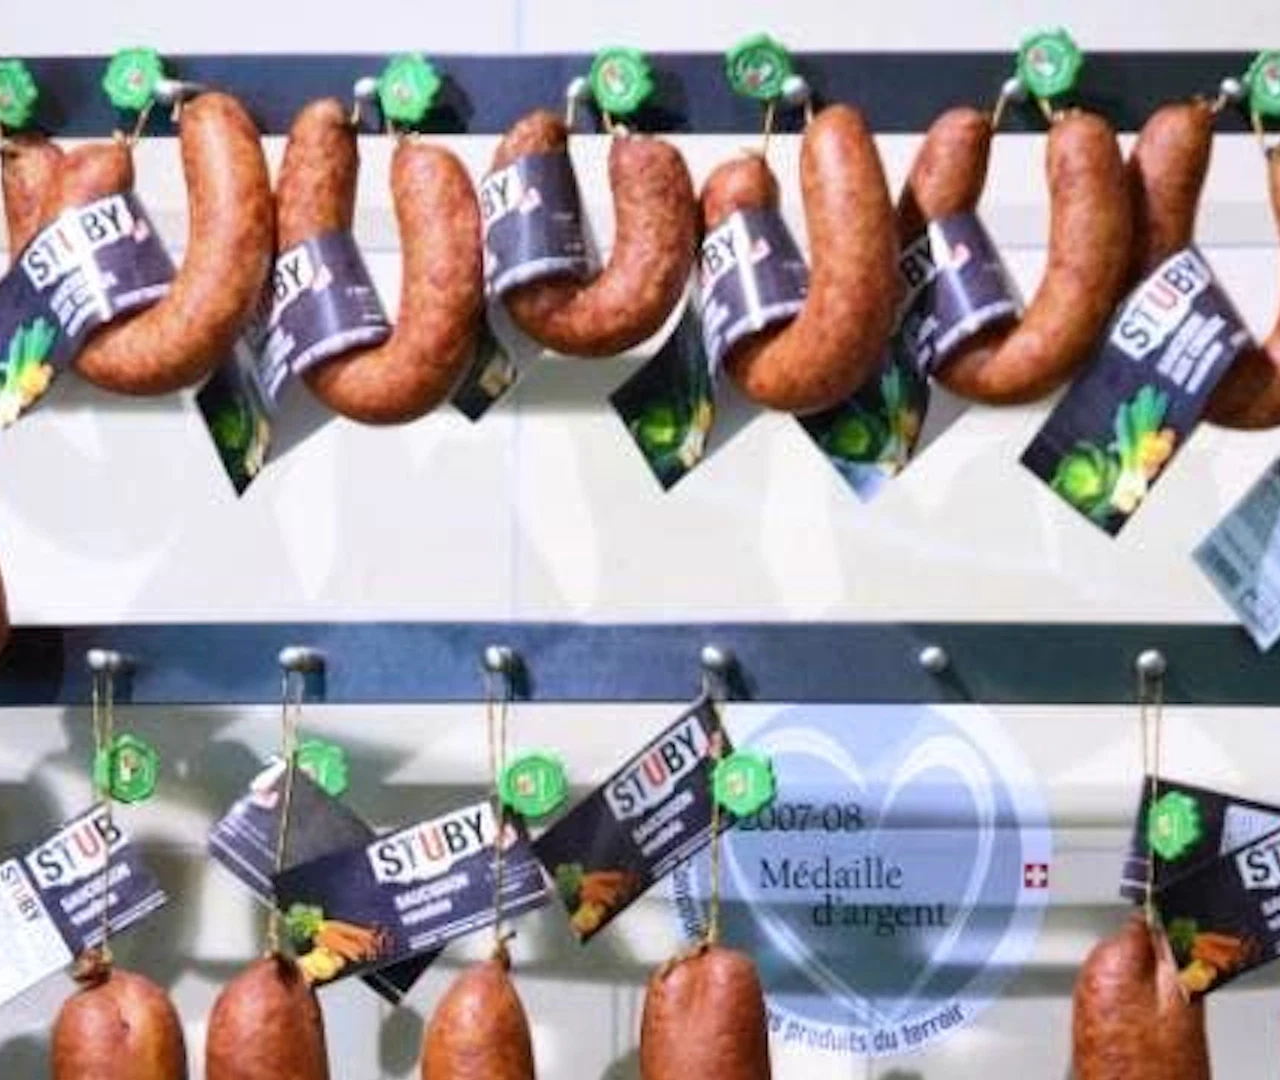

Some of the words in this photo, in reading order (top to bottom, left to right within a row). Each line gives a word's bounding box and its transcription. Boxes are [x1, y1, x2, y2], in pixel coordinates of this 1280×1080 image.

[1119, 255, 1205, 350] STUBY
[612, 724, 700, 814] STUBY
[36, 814, 121, 882] STUB
[377, 811, 485, 877] STUBY
[759, 855, 905, 890] Médaille
[812, 892, 952, 938] d'argent
[873, 1029, 899, 1053] du
[900, 1002, 965, 1045] terroir
